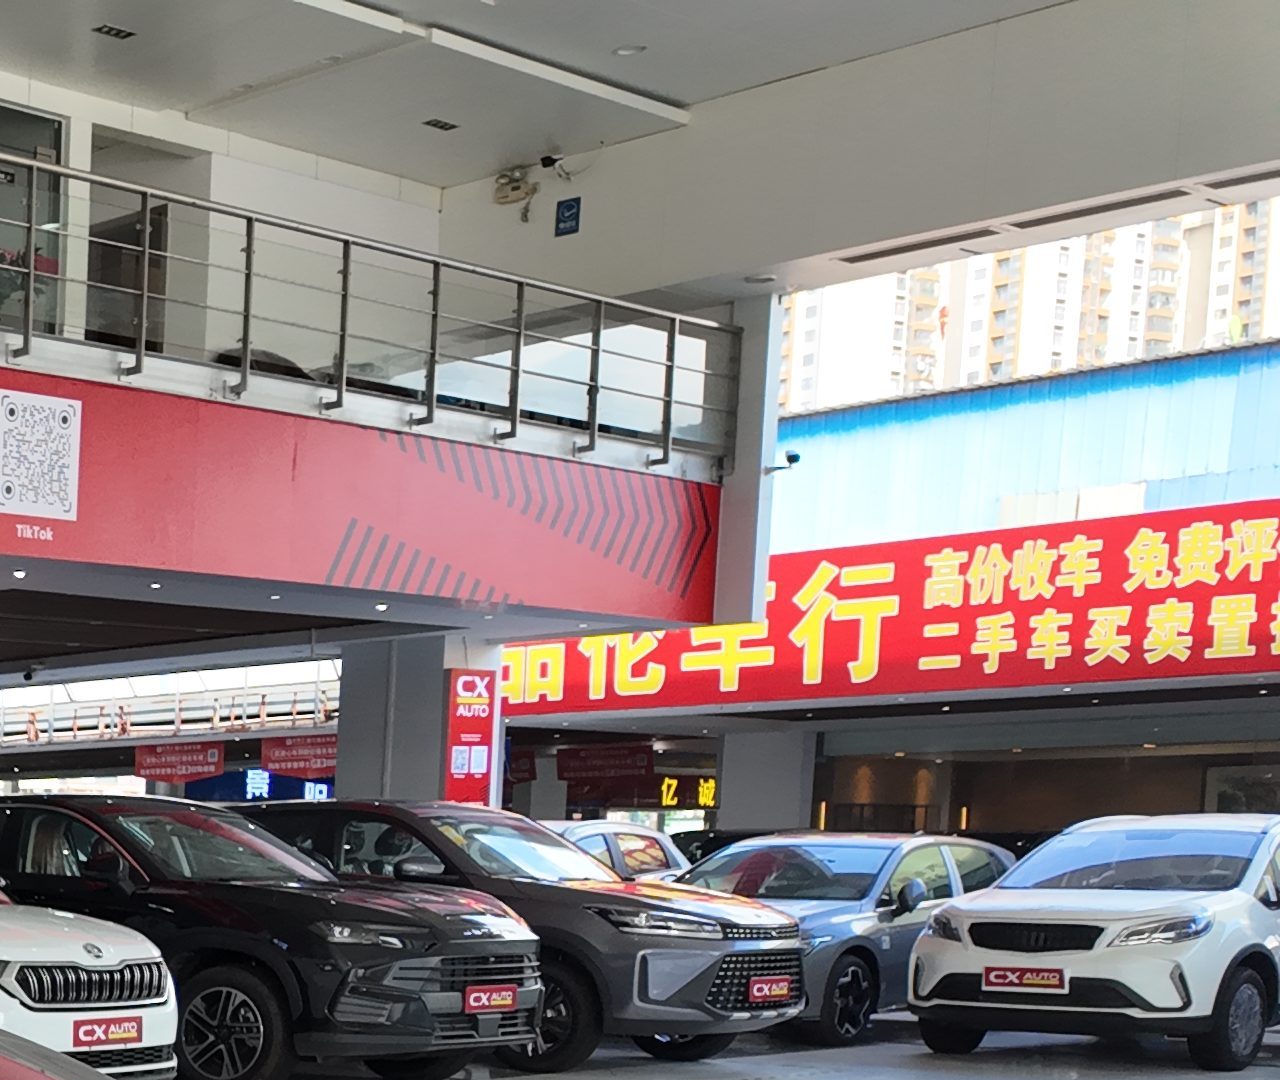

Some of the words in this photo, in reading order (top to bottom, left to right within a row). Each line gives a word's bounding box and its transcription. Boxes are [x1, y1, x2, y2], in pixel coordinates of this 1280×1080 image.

[15, 524, 54, 541] TikTok
[923, 534, 1104, 610] 高价收车
[1123, 517, 1280, 592] 免费评
[918, 592, 1280, 674] 二手车买卖置
[456, 675, 491, 698] CX
[456, 704, 490, 717] AUTO
[988, 970, 1021, 984] CX
[1022, 971, 1060, 981] AUTO
[469, 992, 490, 1007] CX
[491, 990, 513, 1000] AUTO
[753, 983, 771, 997] CX
[79, 1024, 107, 1042] CX
[108, 1021, 138, 1034] AUTO
